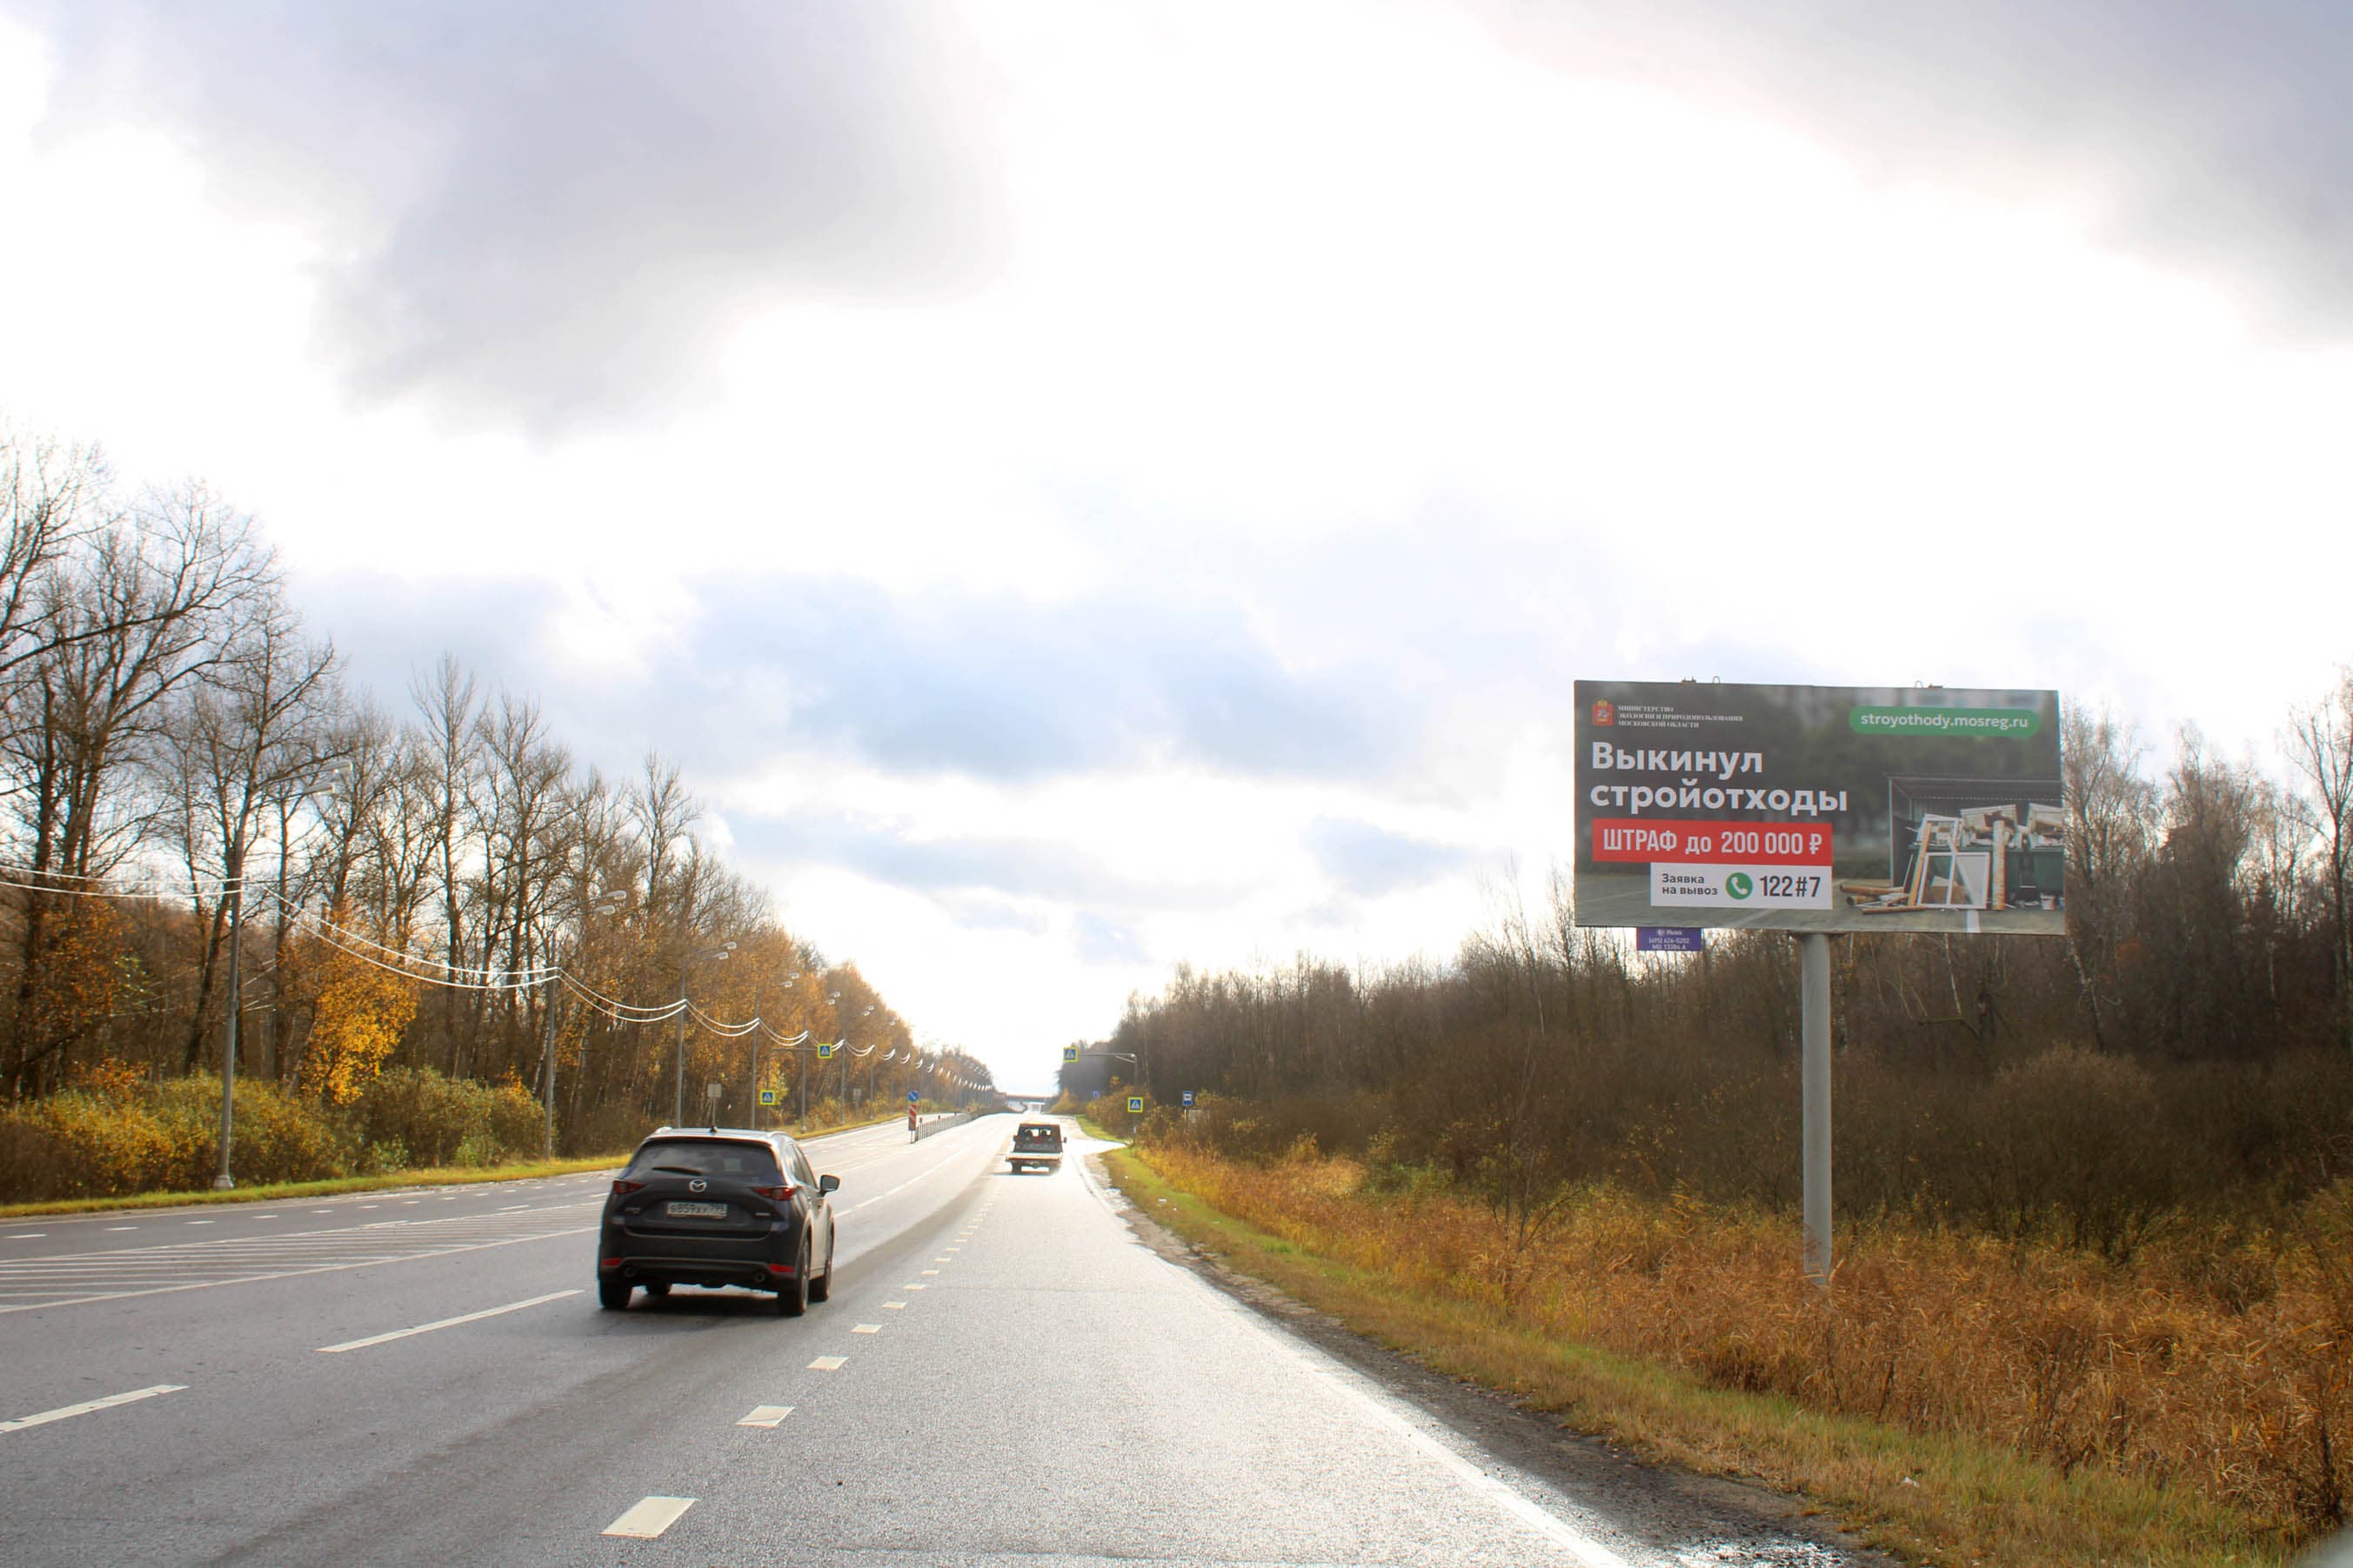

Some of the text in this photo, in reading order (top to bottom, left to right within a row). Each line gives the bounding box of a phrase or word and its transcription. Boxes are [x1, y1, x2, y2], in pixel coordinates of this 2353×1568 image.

[1861, 713, 2029, 731] stroyothody.mosreg.ru
[1592, 741, 1763, 781] Выкинул
[1590, 778, 1848, 816] стройотходы
[1603, 829, 1678, 852] ШТРАФ
[1685, 836, 1712, 855] до
[1721, 831, 1760, 854] 200
[1764, 833, 1803, 855] 000
[1661, 873, 1705, 884] Заявка
[1760, 875, 1822, 897] 122#7
[1662, 886, 1718, 896] на вывоз
